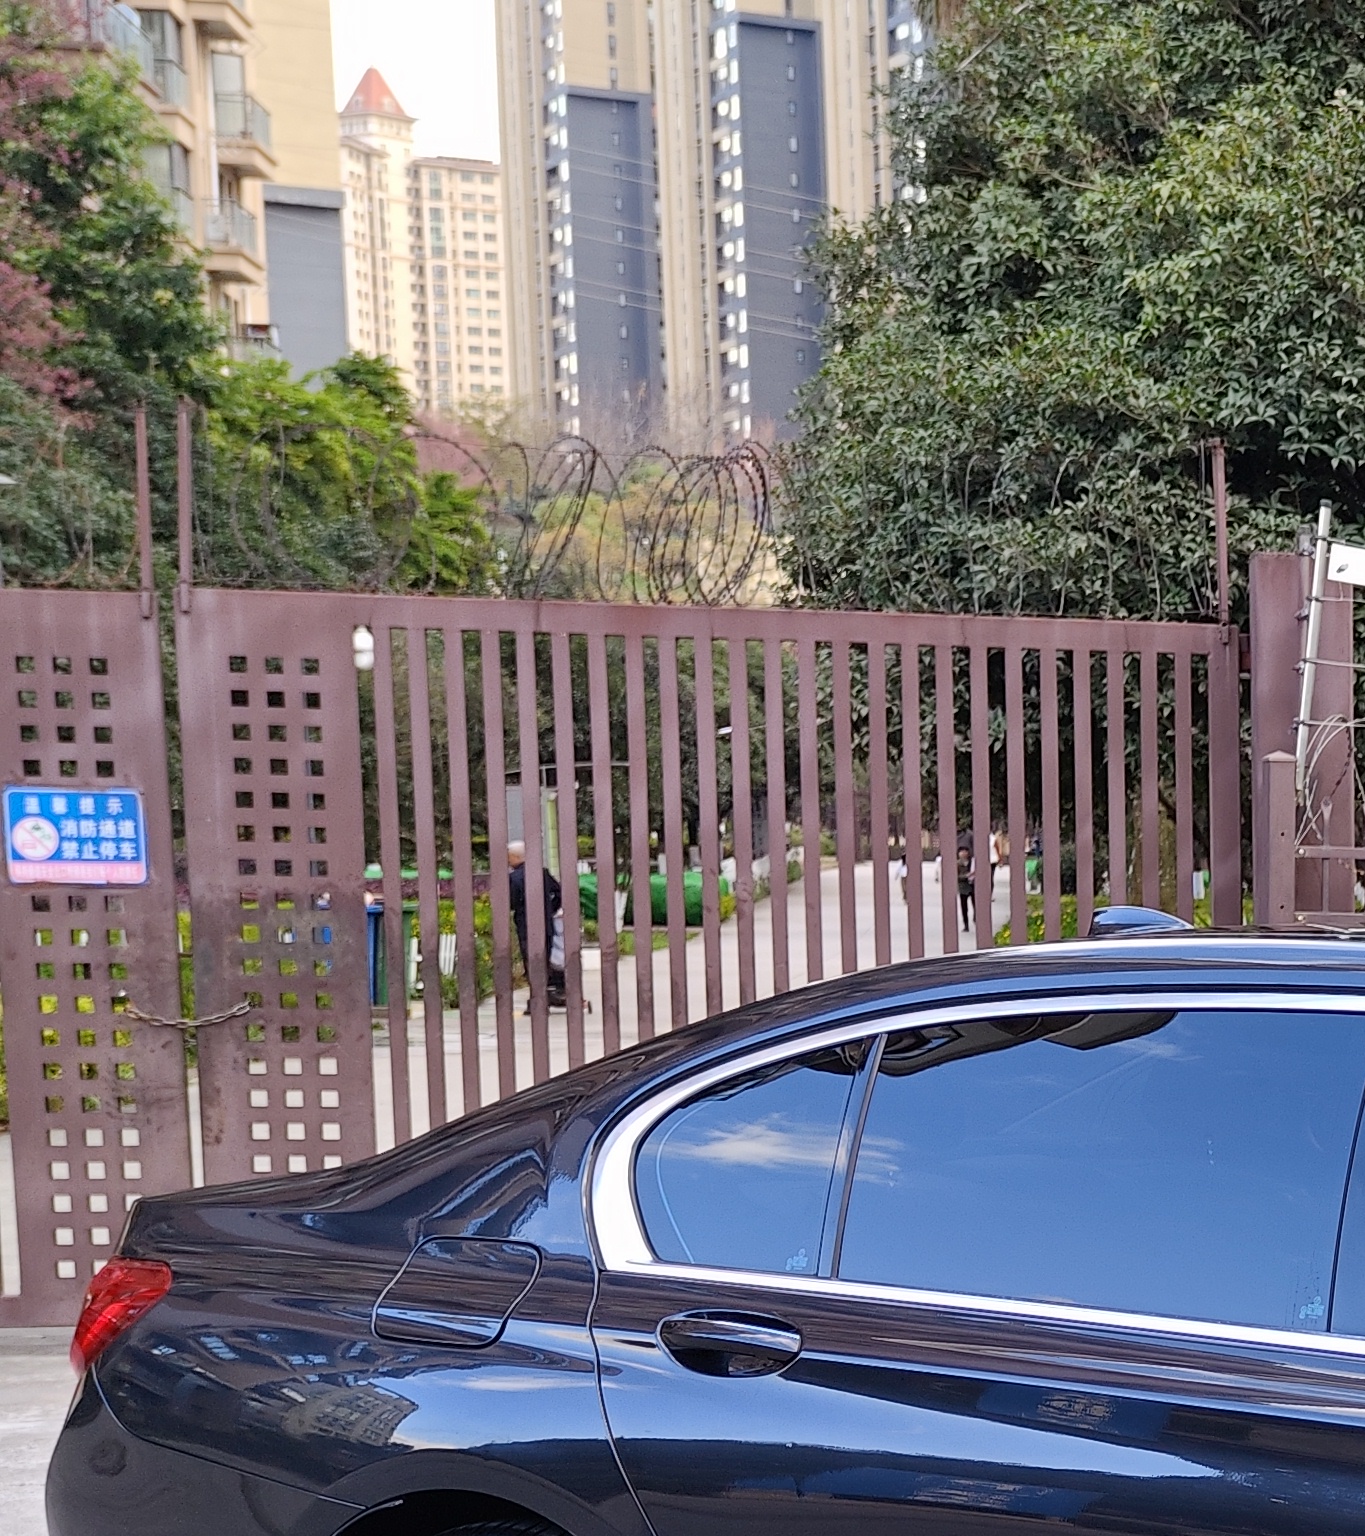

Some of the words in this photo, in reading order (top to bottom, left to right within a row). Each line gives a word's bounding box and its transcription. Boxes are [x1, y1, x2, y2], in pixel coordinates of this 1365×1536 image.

[60, 819, 137, 839] 消防通道
[61, 840, 137, 860] 禁止停车
